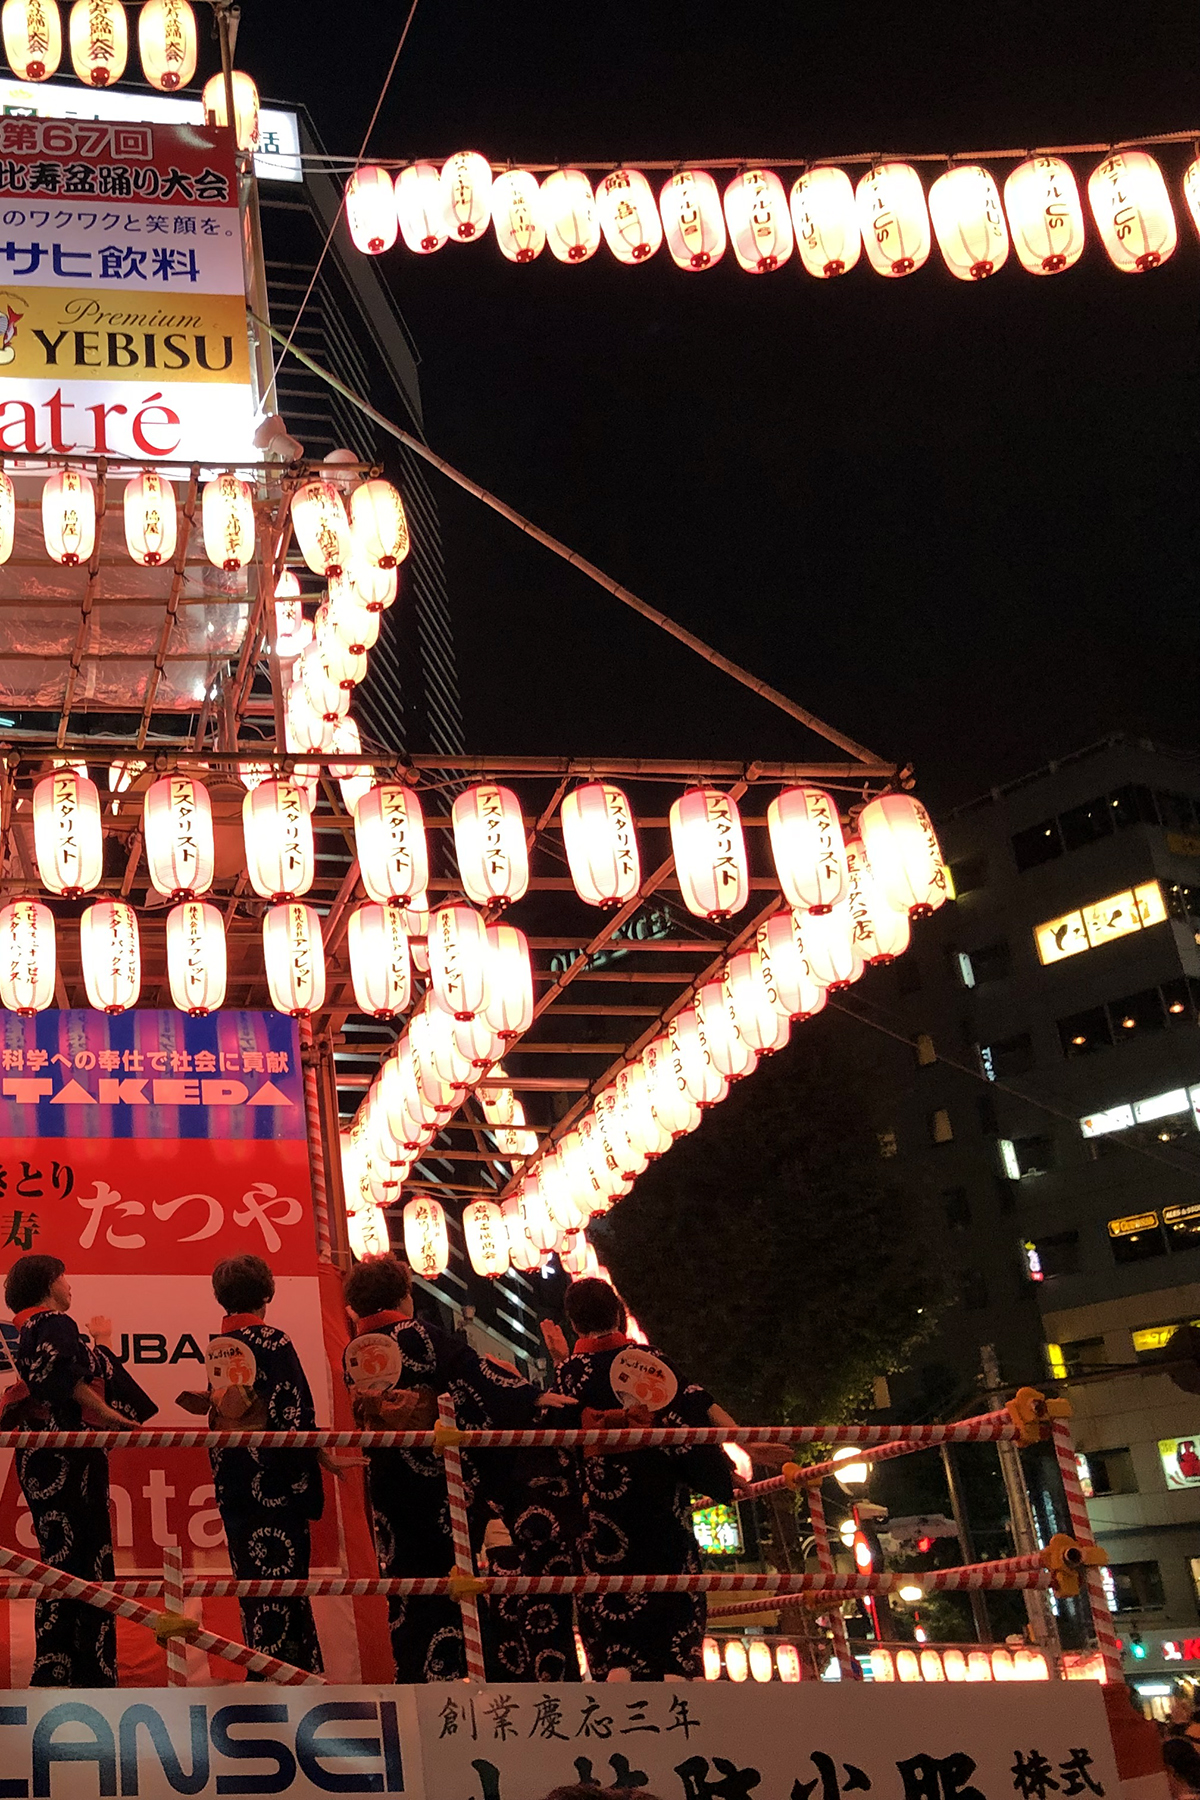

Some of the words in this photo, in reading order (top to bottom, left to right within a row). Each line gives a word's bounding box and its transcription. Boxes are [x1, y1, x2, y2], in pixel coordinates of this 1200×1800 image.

[31, 328, 234, 371] YEBISU
[57, 297, 203, 329] Premium
[53, 778, 78, 864] アスタリスト
[171, 781, 198, 863] アスタリスト
[278, 785, 302, 870] アスタリスト
[382, 790, 410, 873] アスタリスト
[478, 791, 506, 875] アスタリスト
[603, 791, 633, 876] アスタリスト
[704, 795, 738, 886] アスタリスト
[806, 794, 839, 880] アスタリスト
[2, 1049, 290, 1074] 科学への奉仕で社会に貢献
[2, 1078, 294, 1106] TAKEDA
[76, 1182, 304, 1254] たつや
[438, 1695, 701, 1742] 創業慶応三年
